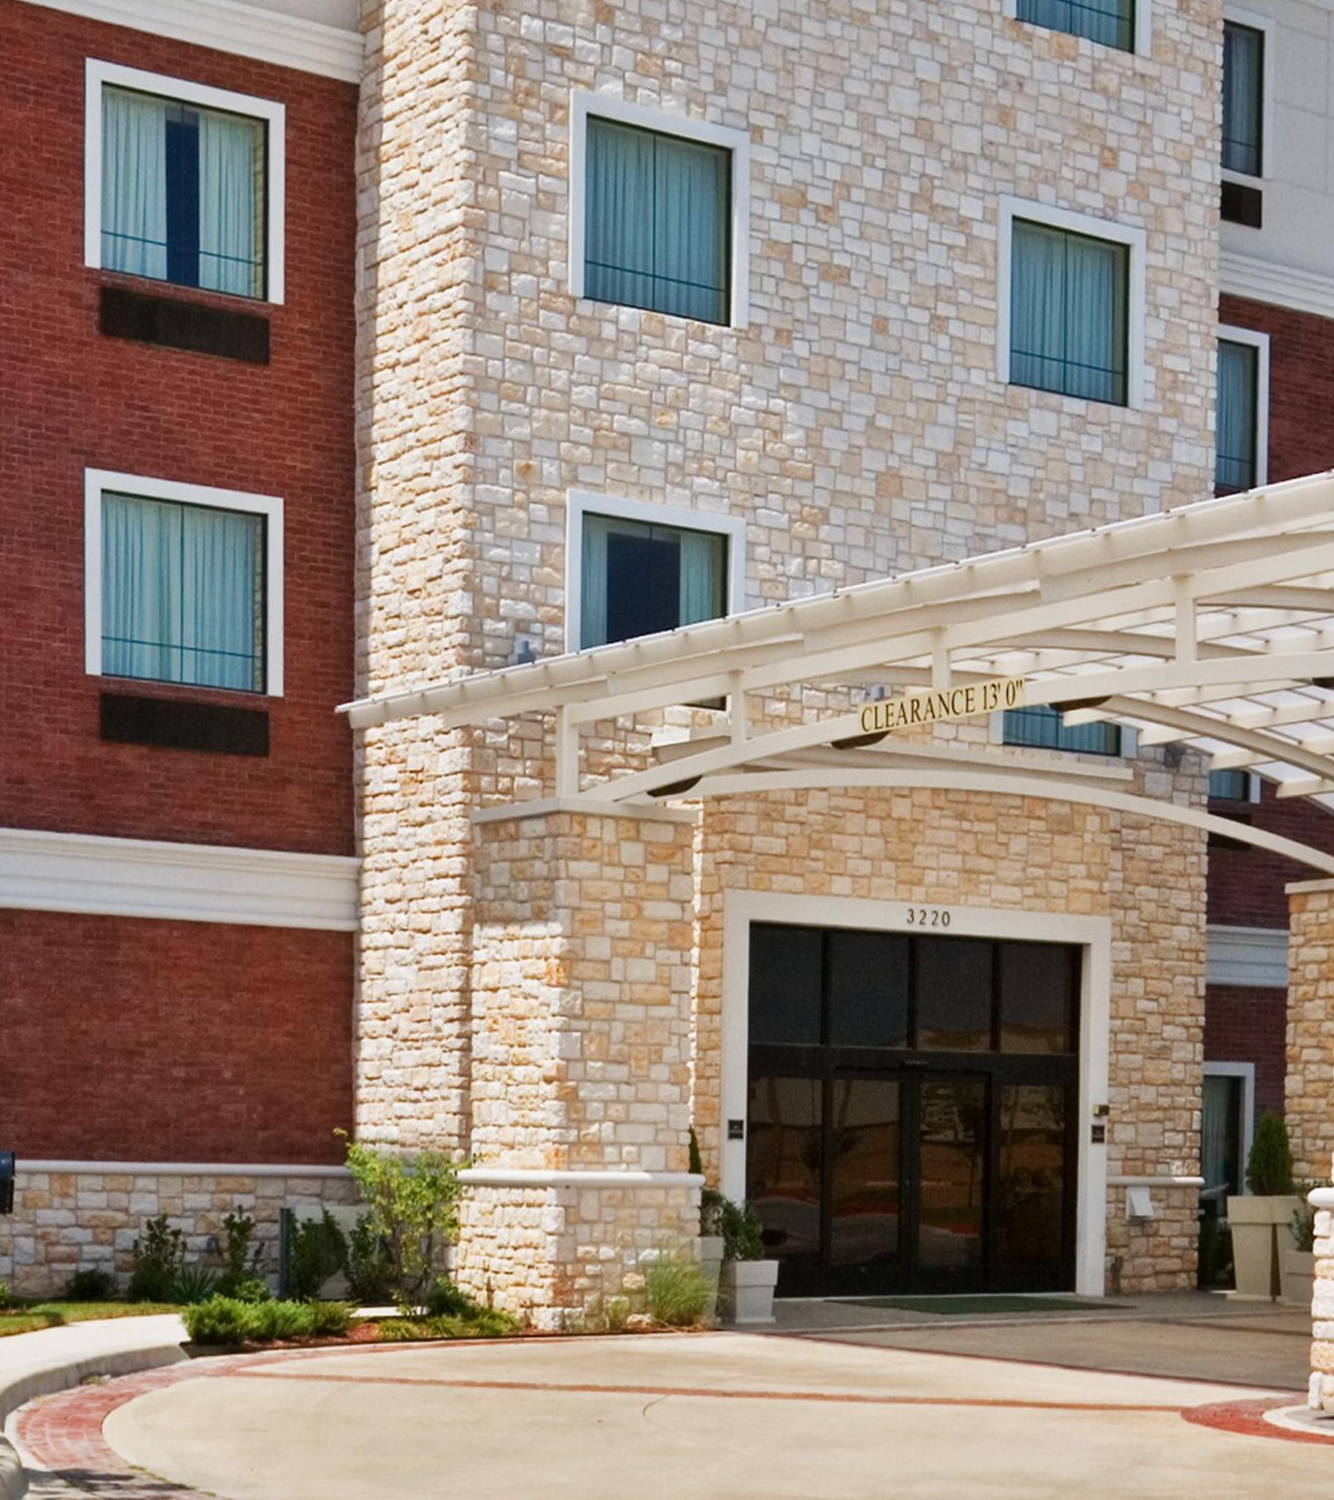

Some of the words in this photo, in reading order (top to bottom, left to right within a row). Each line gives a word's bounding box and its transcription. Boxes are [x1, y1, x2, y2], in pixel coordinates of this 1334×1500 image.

[861, 687, 975, 732] CLEARANCE
[982, 682, 1001, 710] 13'
[906, 908, 951, 927] 3220
